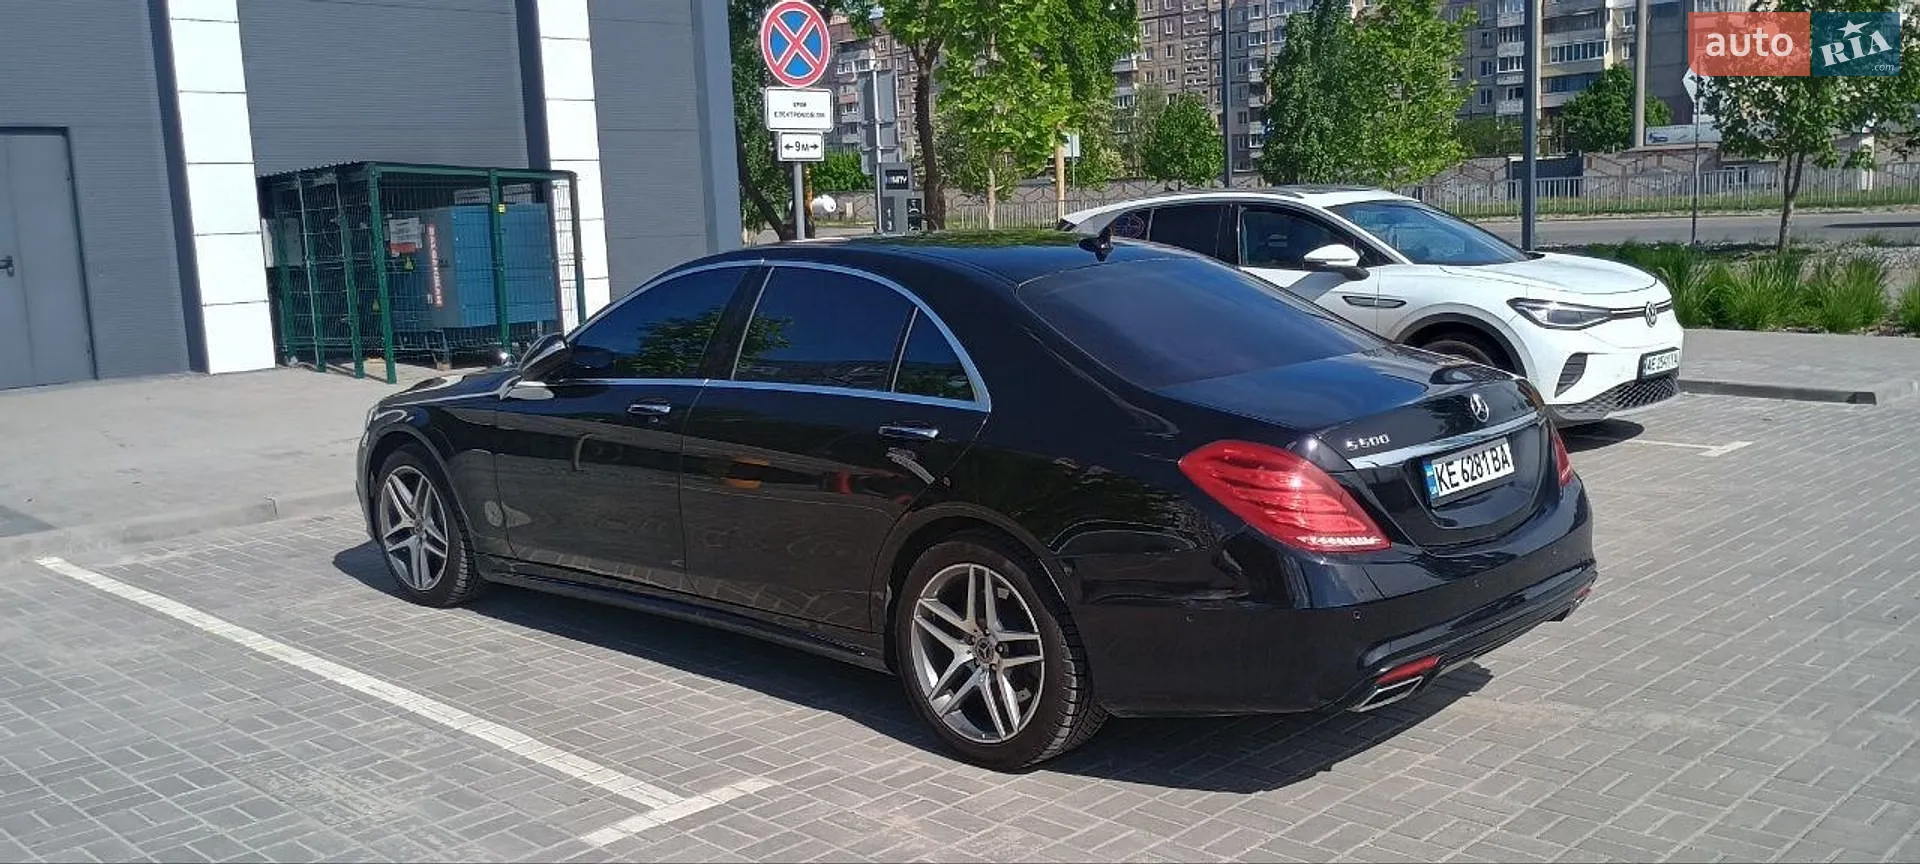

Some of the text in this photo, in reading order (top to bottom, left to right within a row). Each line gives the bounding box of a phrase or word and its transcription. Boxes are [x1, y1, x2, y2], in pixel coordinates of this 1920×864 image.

[1346, 433, 1391, 451] S 500
[1434, 444, 1511, 492] KE 6281 BA
